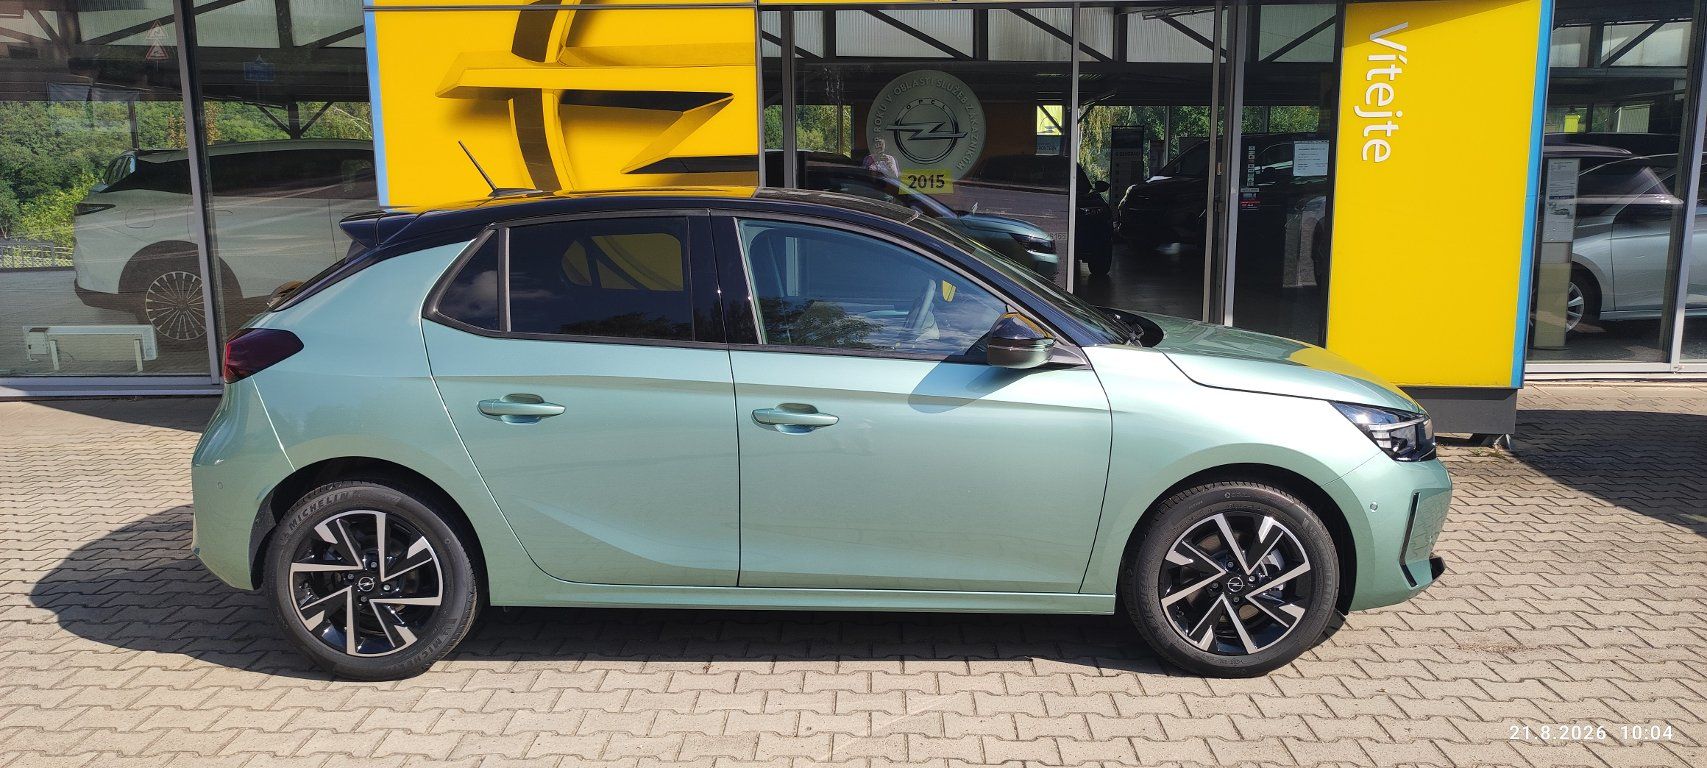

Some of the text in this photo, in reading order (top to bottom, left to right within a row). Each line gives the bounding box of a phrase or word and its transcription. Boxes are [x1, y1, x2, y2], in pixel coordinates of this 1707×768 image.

[874, 103, 887, 131] ROKU
[884, 93, 893, 102] V
[893, 77, 934, 95] OBLASTI
[937, 78, 968, 103] SLUŽEB
[906, 99, 946, 110] OPEL
[1353, 21, 1409, 163] Vítejte
[907, 174, 945, 189] 2015
[288, 491, 349, 531] MICHELIN
